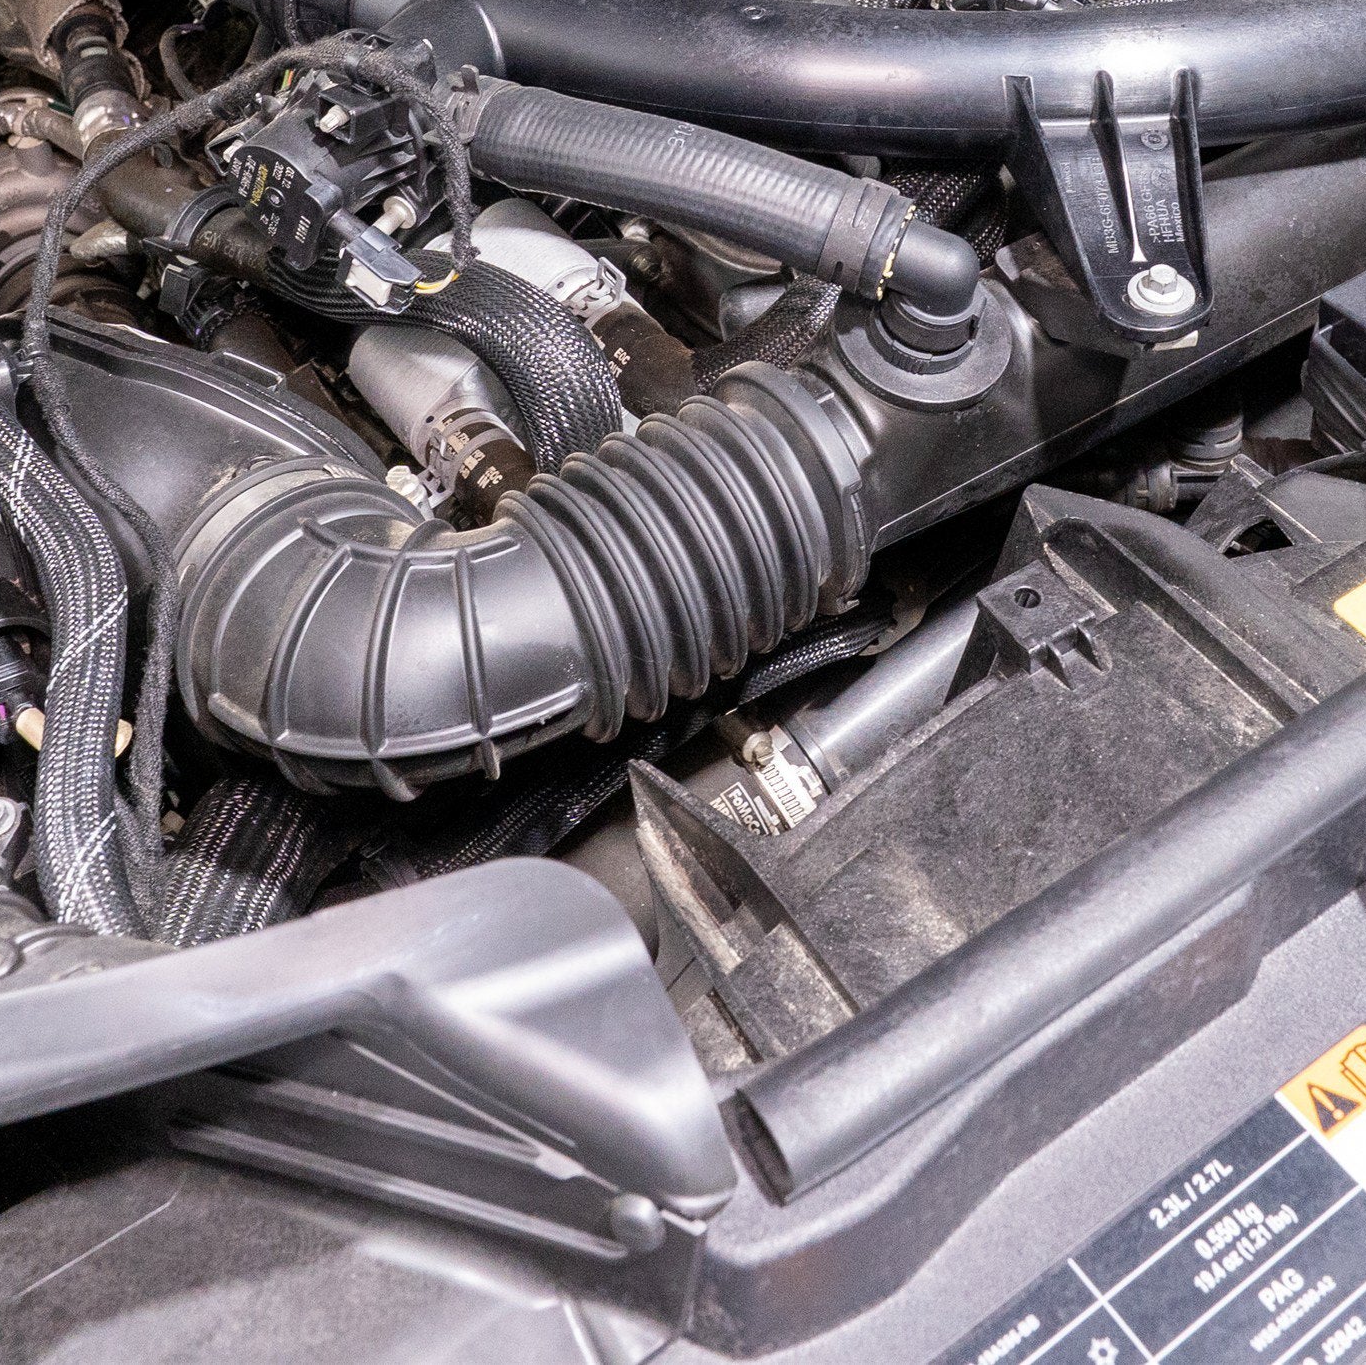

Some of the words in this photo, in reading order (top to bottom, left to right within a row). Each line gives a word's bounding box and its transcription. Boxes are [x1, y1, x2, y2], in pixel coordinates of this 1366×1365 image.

[613, 347, 631, 365] EOC
[484, 465, 503, 485] EOC
[727, 787, 761, 834] FoMoCo
[1147, 1192, 1185, 1230] 2.3L
[1191, 1155, 1233, 1196] 2.7L
[1192, 1213, 1245, 1261] 0.550
[1234, 1198, 1263, 1229] kg
[1192, 1260, 1227, 1294] 19.4
[1257, 1265, 1306, 1313] PAG
